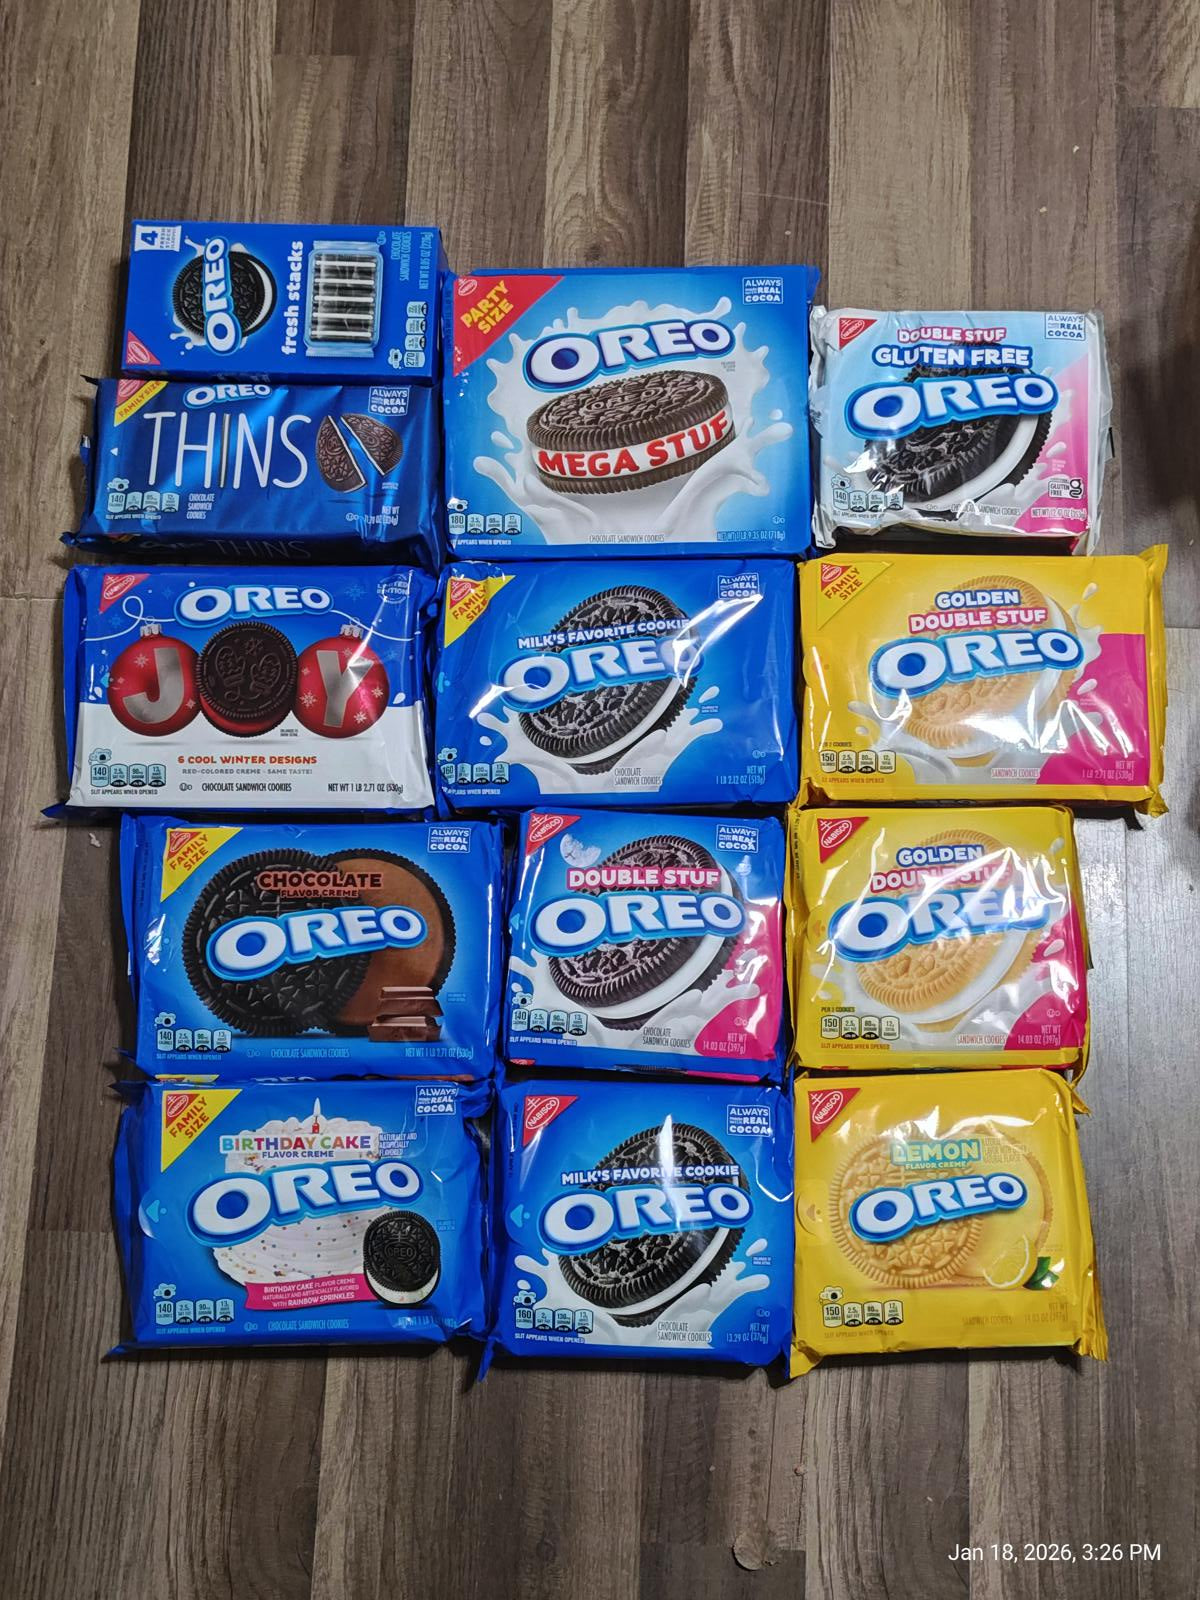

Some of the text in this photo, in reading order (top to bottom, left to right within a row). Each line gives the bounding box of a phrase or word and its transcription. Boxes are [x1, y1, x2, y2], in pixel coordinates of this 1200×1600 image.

[141, 231, 158, 246] 4
[206, 237, 235, 352] OREO
[282, 240, 304, 355] fresh stacks
[745, 294, 781, 302] COCOA
[460, 279, 509, 328] PARTY
[478, 298, 514, 334] SIZE
[1047, 315, 1084, 323] ALWAYS
[899, 327, 1006, 343] DOUBLE STUF
[1047, 330, 1083, 338] COCOA
[530, 320, 731, 384] OREO
[875, 348, 1029, 366] GLUTEN FREE
[186, 384, 270, 406] OREO
[372, 389, 408, 398] ALWAYS
[118, 395, 145, 418] FAMILY
[370, 404, 405, 414] COCOA
[383, 398, 406, 406] REAL
[853, 376, 1054, 431] OREO
[144, 411, 311, 489] THINS
[538, 410, 729, 478] MEGA STUF
[589, 535, 616, 543] CHOCOLATE
[617, 535, 644, 543] SANDWICH
[720, 575, 757, 584] ALWAYS
[824, 567, 860, 599] FAMILY
[839, 579, 864, 600] SIZE
[180, 587, 331, 621] OREO
[452, 585, 487, 620] FAMILY
[937, 590, 1019, 607] GOLDEN
[910, 610, 1047, 633] DOUBLE STUF
[518, 633, 566, 649] MILK'S
[567, 624, 635, 643] FAVORITE
[877, 631, 1079, 690] OREO
[504, 638, 700, 703] OREO
[178, 755, 317, 764] 6 COOL WINTER DESIGNS
[821, 753, 835, 761] 150
[93, 766, 107, 776] 140
[614, 768, 642, 777] CHOCOLATE
[201, 783, 292, 792] CHOCOLATE SANDWICH COOKIES
[328, 783, 338, 792] NET
[339, 783, 349, 792] WT
[355, 783, 362, 792] LB
[363, 783, 375, 792] 2.71
[377, 783, 385, 792] OZ
[614, 777, 662, 785] SANDWICH COOKIES
[431, 829, 469, 837] ALWAYS
[719, 827, 757, 836] ALWAYS
[732, 835, 756, 843] REAL
[823, 820, 850, 847] NABISCO
[430, 843, 467, 851] COCOA
[444, 836, 468, 844] REAL
[718, 842, 756, 851] COCOA
[169, 834, 208, 871] FAMILY
[183, 846, 209, 871] SIZE
[900, 847, 982, 864] GOLDEN
[260, 872, 382, 888] CHOCOLATE
[569, 870, 719, 887] DOUBLE STUF
[872, 867, 958, 891] DOU
[281, 889, 359, 897] FLAVOR CREME
[535, 895, 742, 946] OREO
[835, 890, 1050, 951] ORE
[215, 908, 422, 971] OREO
[824, 1018, 838, 1027] 150
[159, 1031, 172, 1040] 140
[643, 1027, 672, 1037] CHOCOLATE
[642, 1037, 692, 1048] SANDWICH COOKIES
[419, 1088, 456, 1096] ALWAYS
[430, 1095, 454, 1104] REAL
[416, 1104, 454, 1113] COCOA
[527, 1099, 558, 1128] NABISCO
[730, 1108, 769, 1116] ALWAYS
[814, 1092, 841, 1122] NABISCO
[169, 1096, 207, 1138] FAMILY
[743, 1116, 769, 1125] REAL
[184, 1112, 210, 1139] SIZE
[729, 1125, 767, 1134] COCOA
[222, 1135, 371, 1151] BIRTHDAY CAKE
[262, 1150, 335, 1159] FLAVOR CREME
[892, 1141, 980, 1163] LEMON
[905, 1160, 967, 1170] FLAVOR CREME
[562, 1165, 739, 1185] MILK'S FAVORIE COOKIE
[193, 1162, 420, 1236] OREO
[856, 1175, 1024, 1235] OREO
[544, 1187, 749, 1244] OREO
[264, 1277, 356, 1294] BIRTHDAY CAKE FLAVOR CREME
[262, 1292, 290, 1301] NATURALLY
[272, 1292, 355, 1308] WITH RAINBOW SPRINKLES
[158, 1303, 172, 1313] 140
[518, 1310, 532, 1319] 160
[826, 1306, 840, 1315] 150
[267, 1319, 349, 1331] CHOCOLATE SANDWICH COOKIES
[658, 1321, 688, 1331] CHOCOLATE
[657, 1331, 712, 1342] SANDWICH COOKIES
